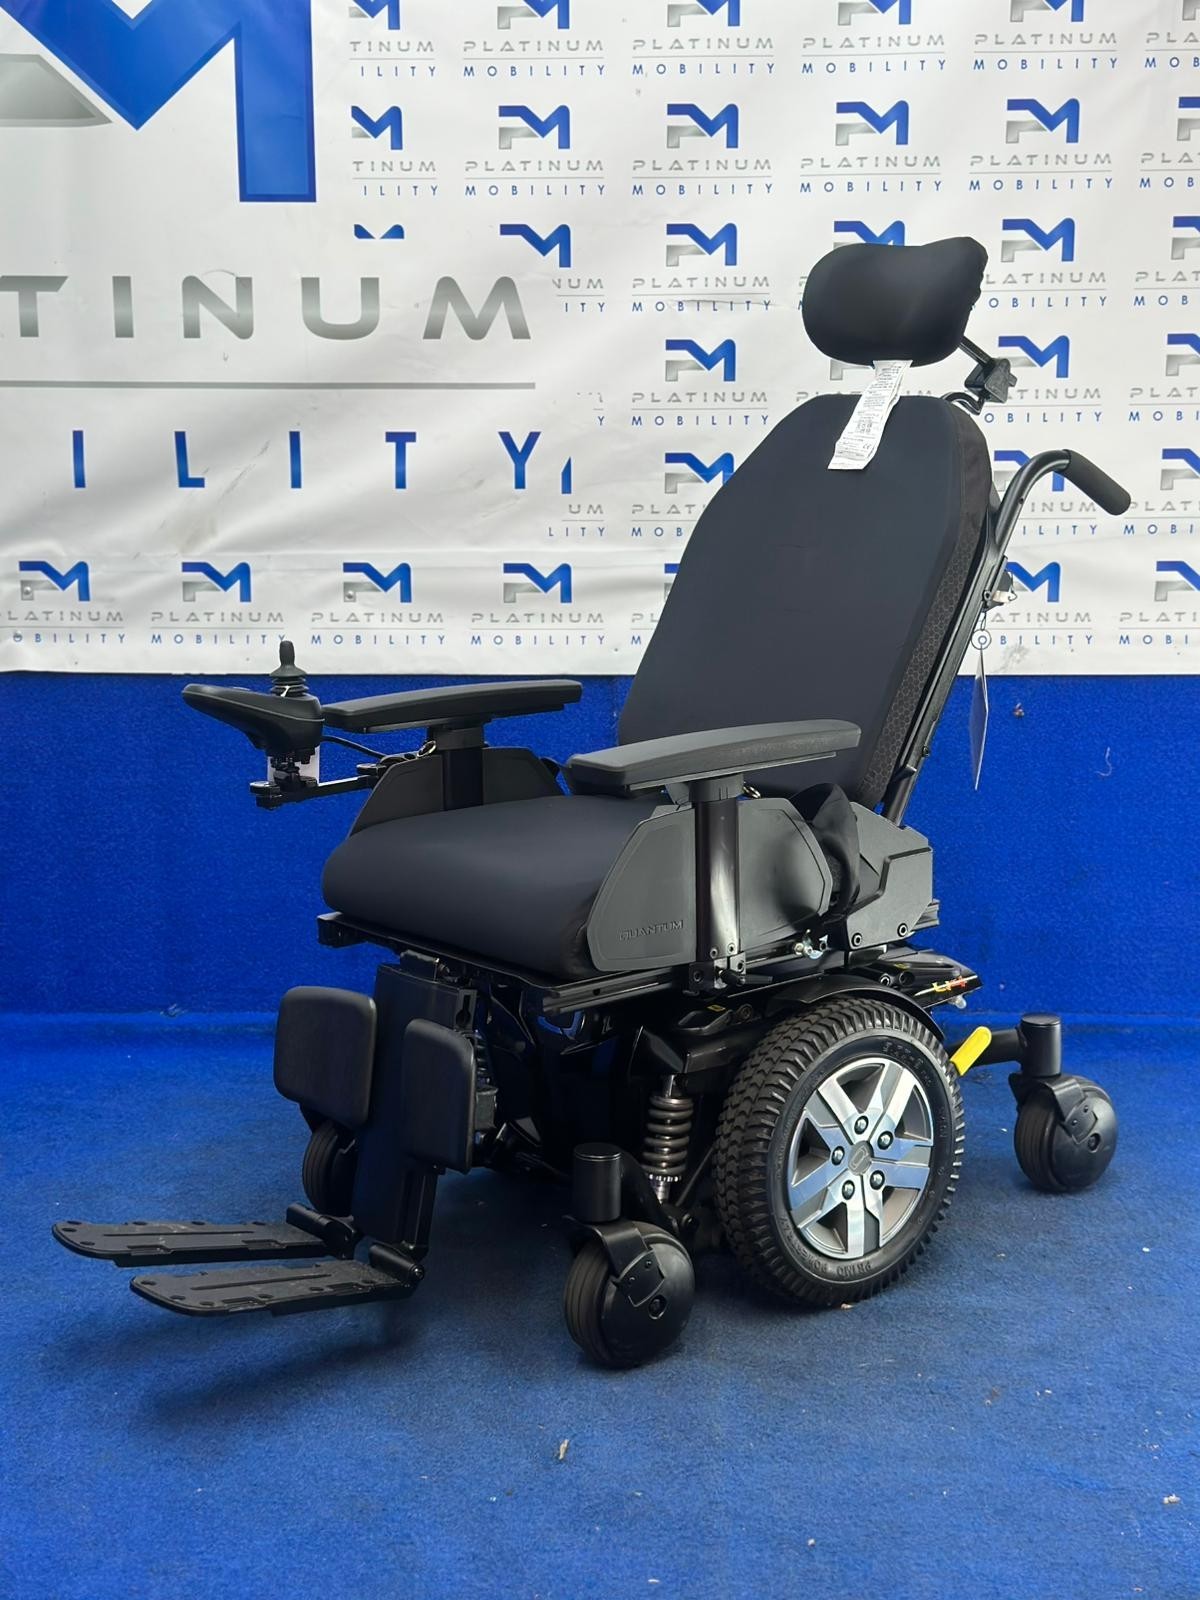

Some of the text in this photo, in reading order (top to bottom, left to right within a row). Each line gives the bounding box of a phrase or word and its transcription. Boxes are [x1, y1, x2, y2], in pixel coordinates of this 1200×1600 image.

[633, 37, 774, 50] PLATINUM
[802, 34, 944, 49] PLATINUM
[975, 33, 1117, 46] PLATINUM
[463, 40, 603, 52] PLATINUM
[632, 62, 775, 75] MOBILITY
[801, 59, 946, 74] MOBILITY
[973, 56, 1119, 70] MOBILITY
[463, 64, 605, 77] MOBILITY
[632, 159, 771, 171] PLATINUM
[801, 155, 941, 169] PLATINUM
[970, 153, 1112, 166] PLATINUM
[465, 160, 604, 172] PLATINUM
[465, 184, 605, 196] MOBILITY
[632, 183, 772, 195] MOBILITY
[800, 178, 942, 193] MOBILITY
[969, 177, 1112, 191] MOBILITY
[632, 276, 770, 288] PLATINUM
[986, 271, 1106, 283] LATINUM
[632, 301, 770, 311] MOBILITY
[988, 296, 1107, 308] OBILITY
[632, 392, 767, 403] PLATINUM
[1010, 388, 1101, 400] TINUM
[632, 415, 768, 425] MOBILITY
[0, 610, 124, 622] LATINUM
[151, 611, 284, 623] PLATINUM
[312, 612, 444, 623] PLATINUM
[471, 612, 604, 623] PLATINUM
[991, 612, 1091, 623] ATINUM
[151, 633, 287, 645] MOBILITY
[310, 634, 445, 645] MOBILITY
[470, 635, 605, 645] MOBILITY
[618, 920, 684, 941] QUANTUM
